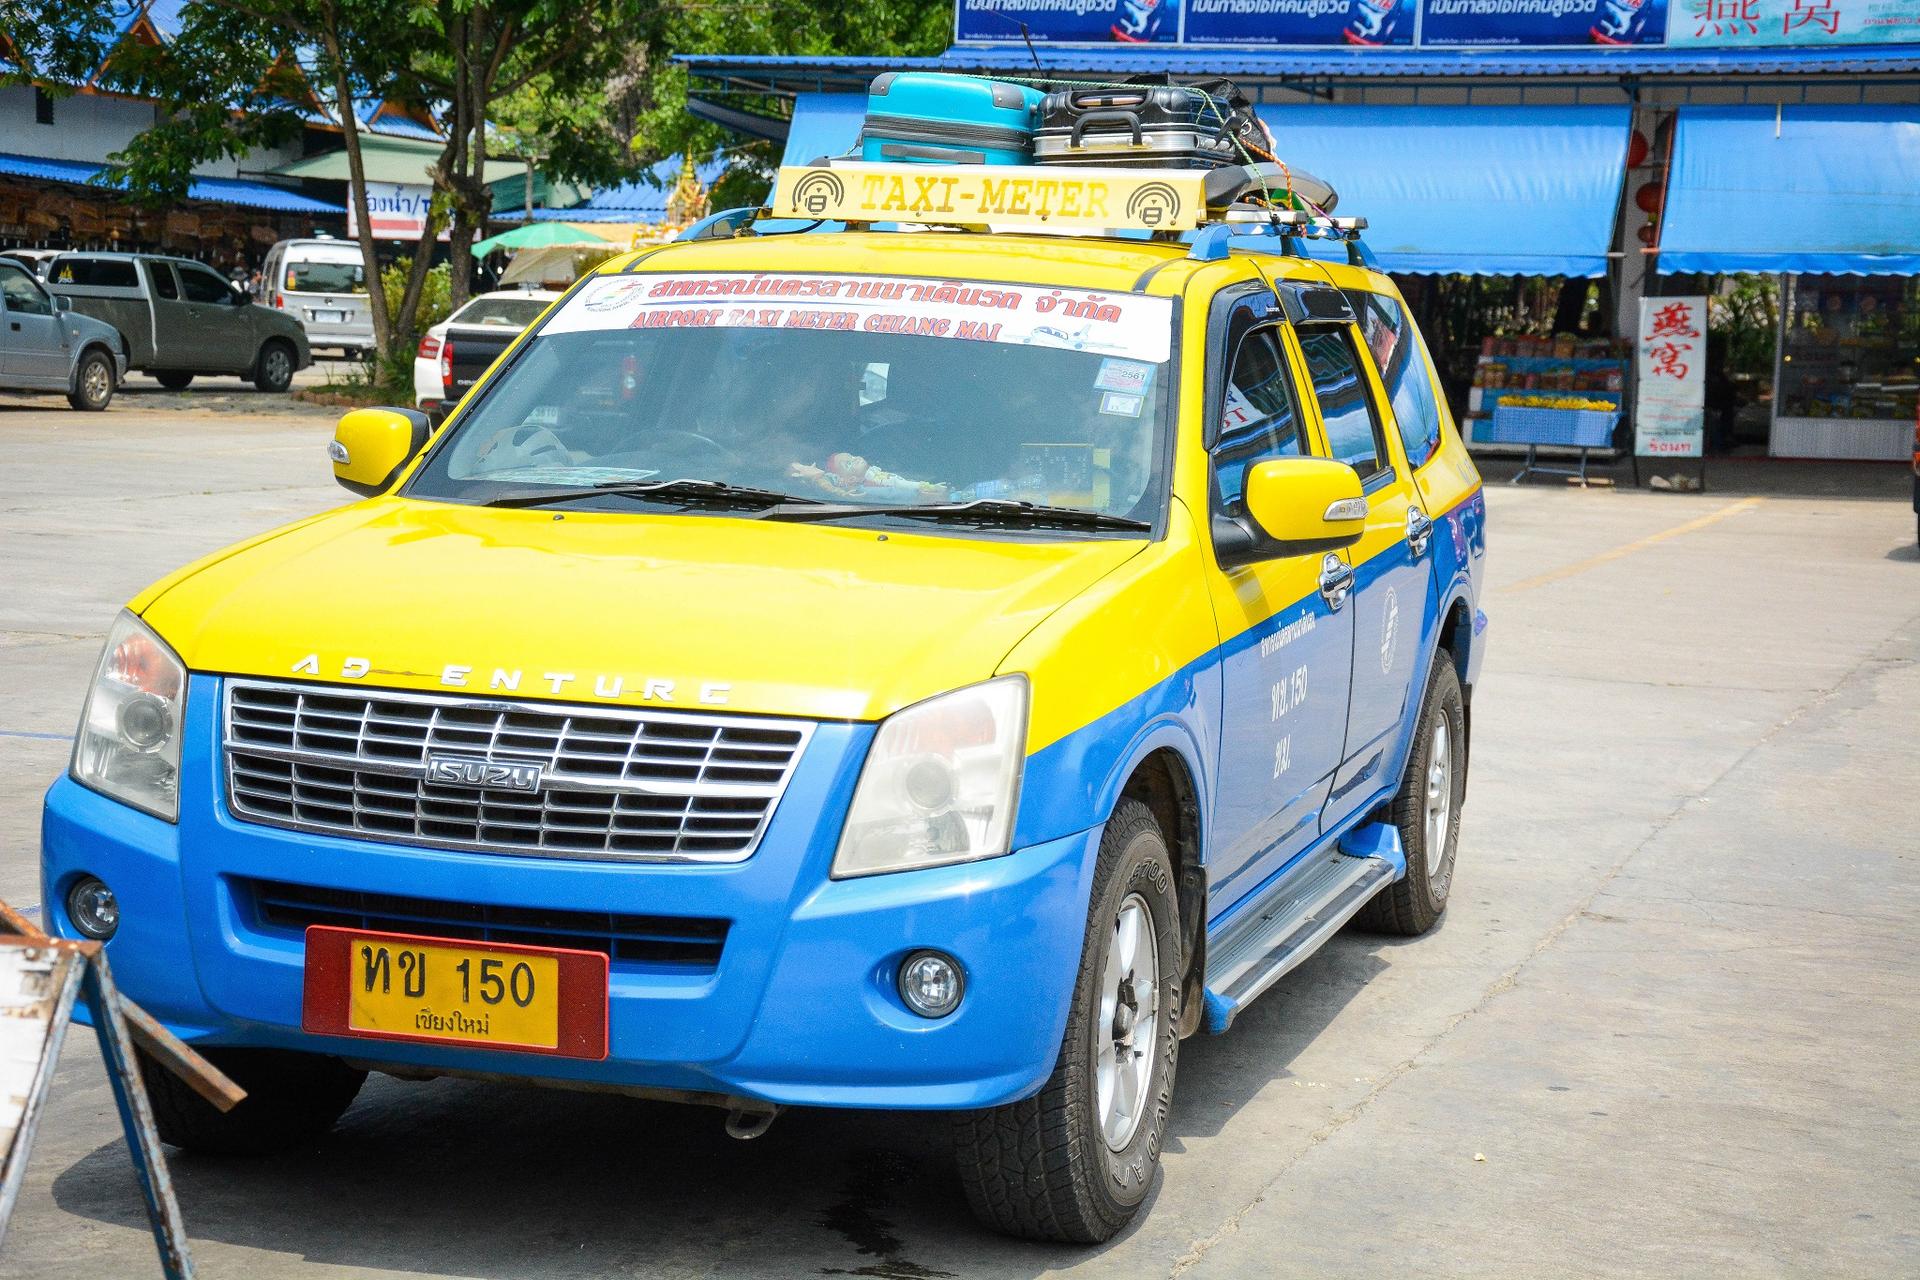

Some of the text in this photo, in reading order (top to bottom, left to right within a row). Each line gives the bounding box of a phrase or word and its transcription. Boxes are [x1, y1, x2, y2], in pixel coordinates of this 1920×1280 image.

[860, 174, 1110, 219] TAXI-METER
[1035, 290, 1122, 323] จำกัด
[627, 309, 1003, 341] AIRPORT TAXI METER CHIANG MAI
[1121, 370, 1146, 381] 2561
[1290, 664, 1308, 709] 150
[429, 759, 537, 790] ISUZU
[361, 944, 536, 1008] ทข 150
[414, 1007, 490, 1035] เชียงใหม่
